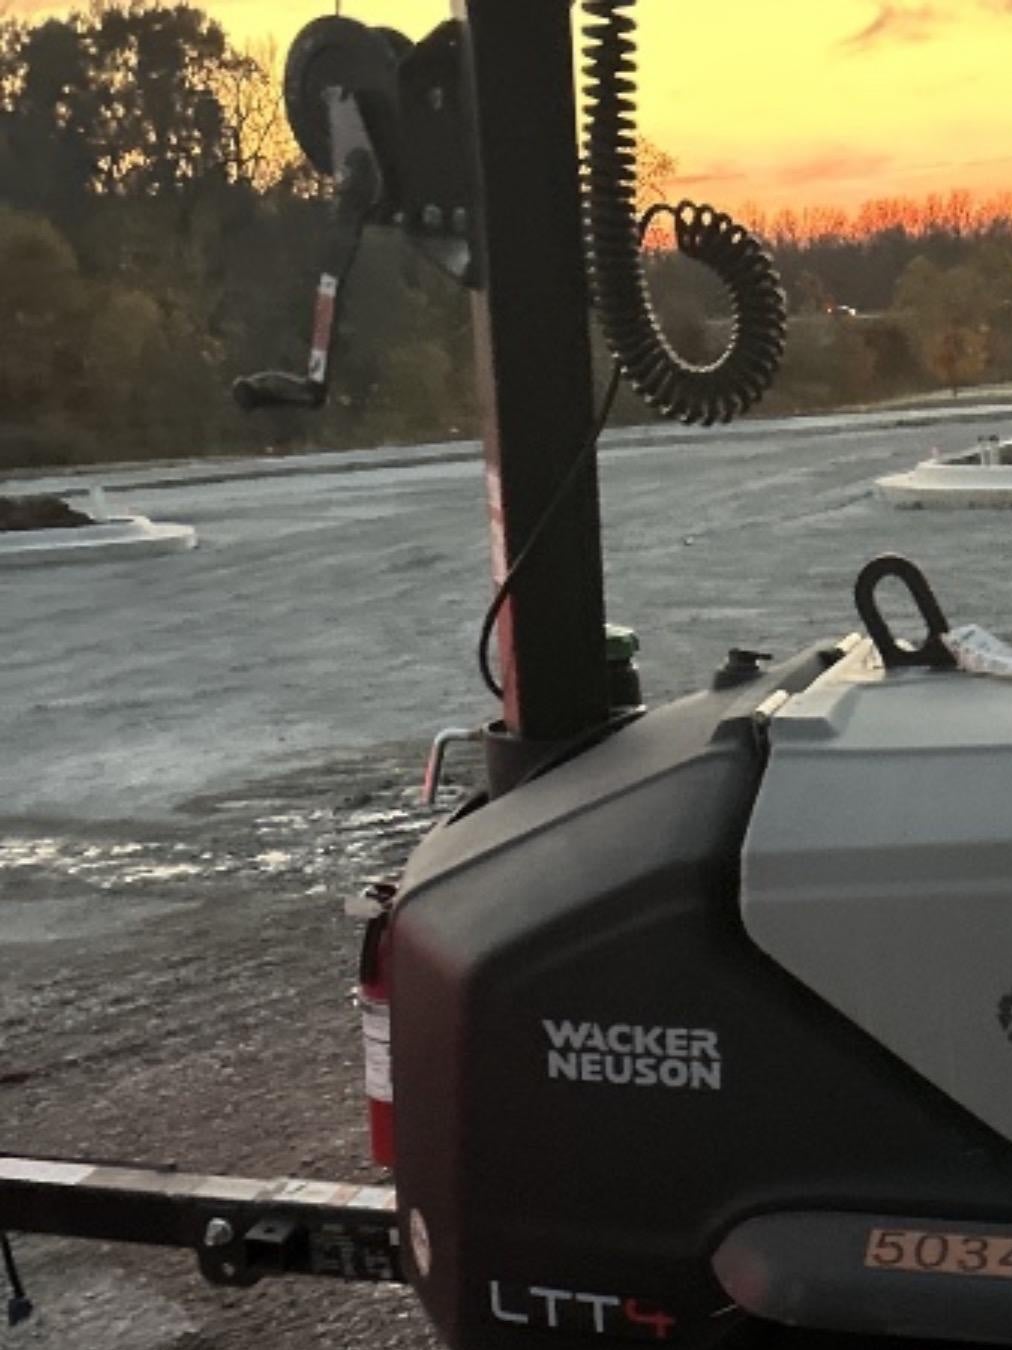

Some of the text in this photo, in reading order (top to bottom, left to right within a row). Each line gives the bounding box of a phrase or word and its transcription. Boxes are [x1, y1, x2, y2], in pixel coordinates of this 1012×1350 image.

[542, 1019, 721, 1059] WACKER
[548, 1049, 722, 1091] NEUSON
[489, 1279, 677, 1340] LTT4
